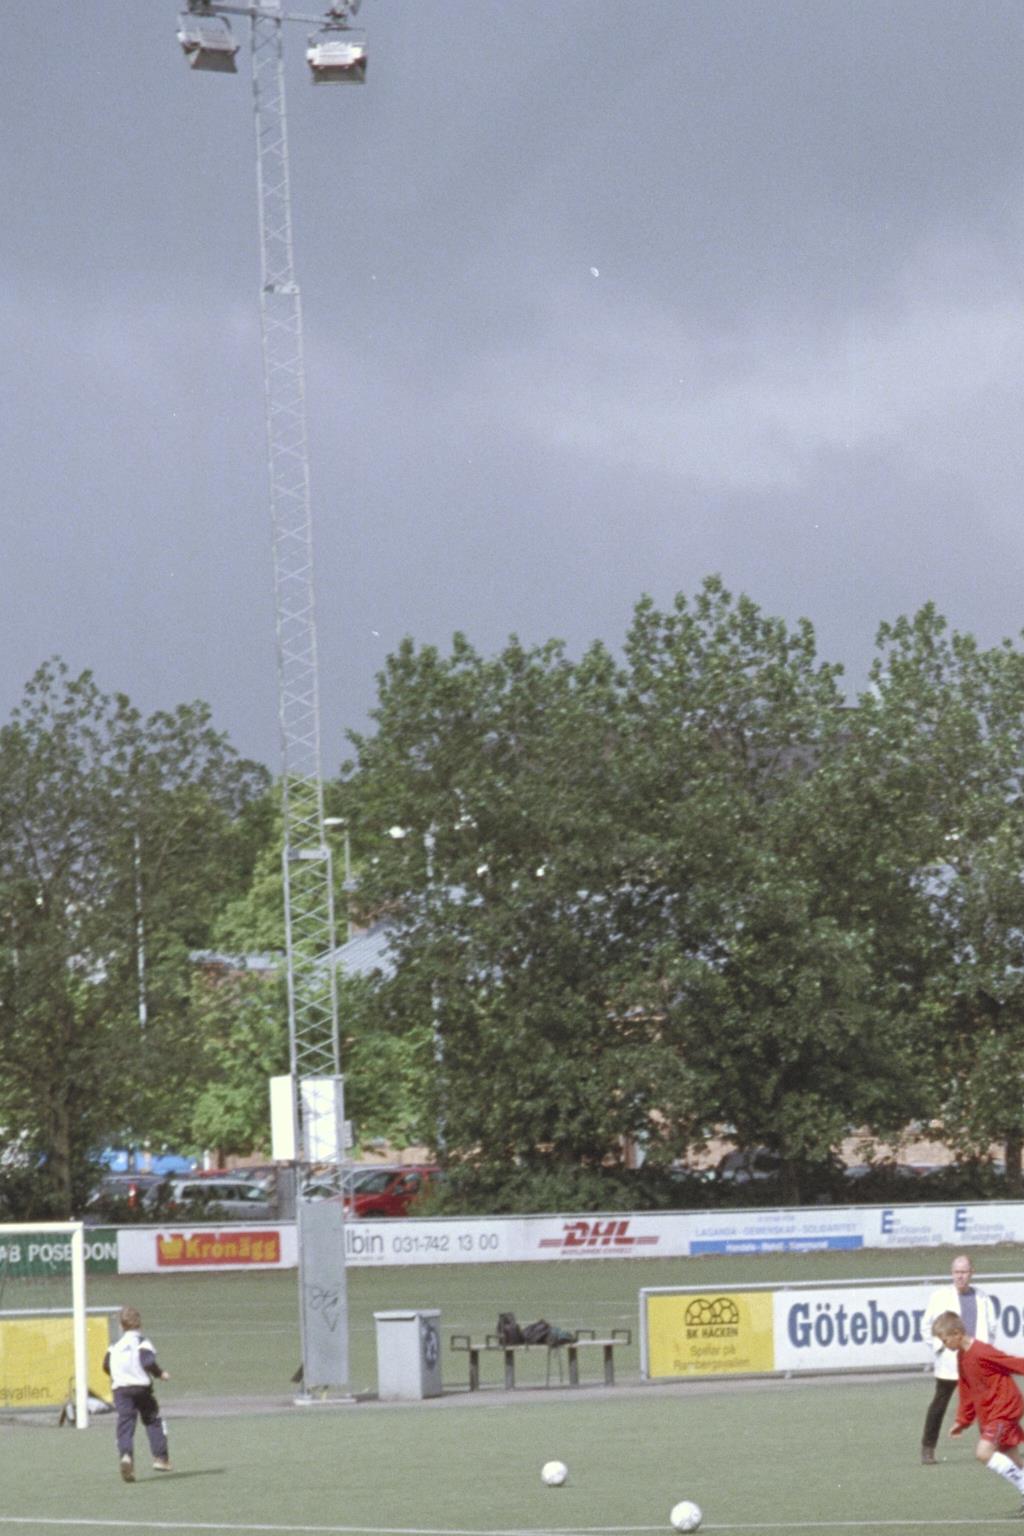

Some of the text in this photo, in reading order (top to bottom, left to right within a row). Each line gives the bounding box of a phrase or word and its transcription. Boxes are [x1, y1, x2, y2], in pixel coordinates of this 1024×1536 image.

[392, 1233, 450, 1252] 031-742
[458, 1233, 474, 1251] 13
[480, 1233, 499, 1250] 00
[562, 1220, 636, 1246] DHL
[28, 1242, 117, 1262] POSEDON
[185, 1237, 278, 1262] Kronägg
[702, 1326, 739, 1338] HÄCKEN
[787, 1299, 925, 1348] Götebor
